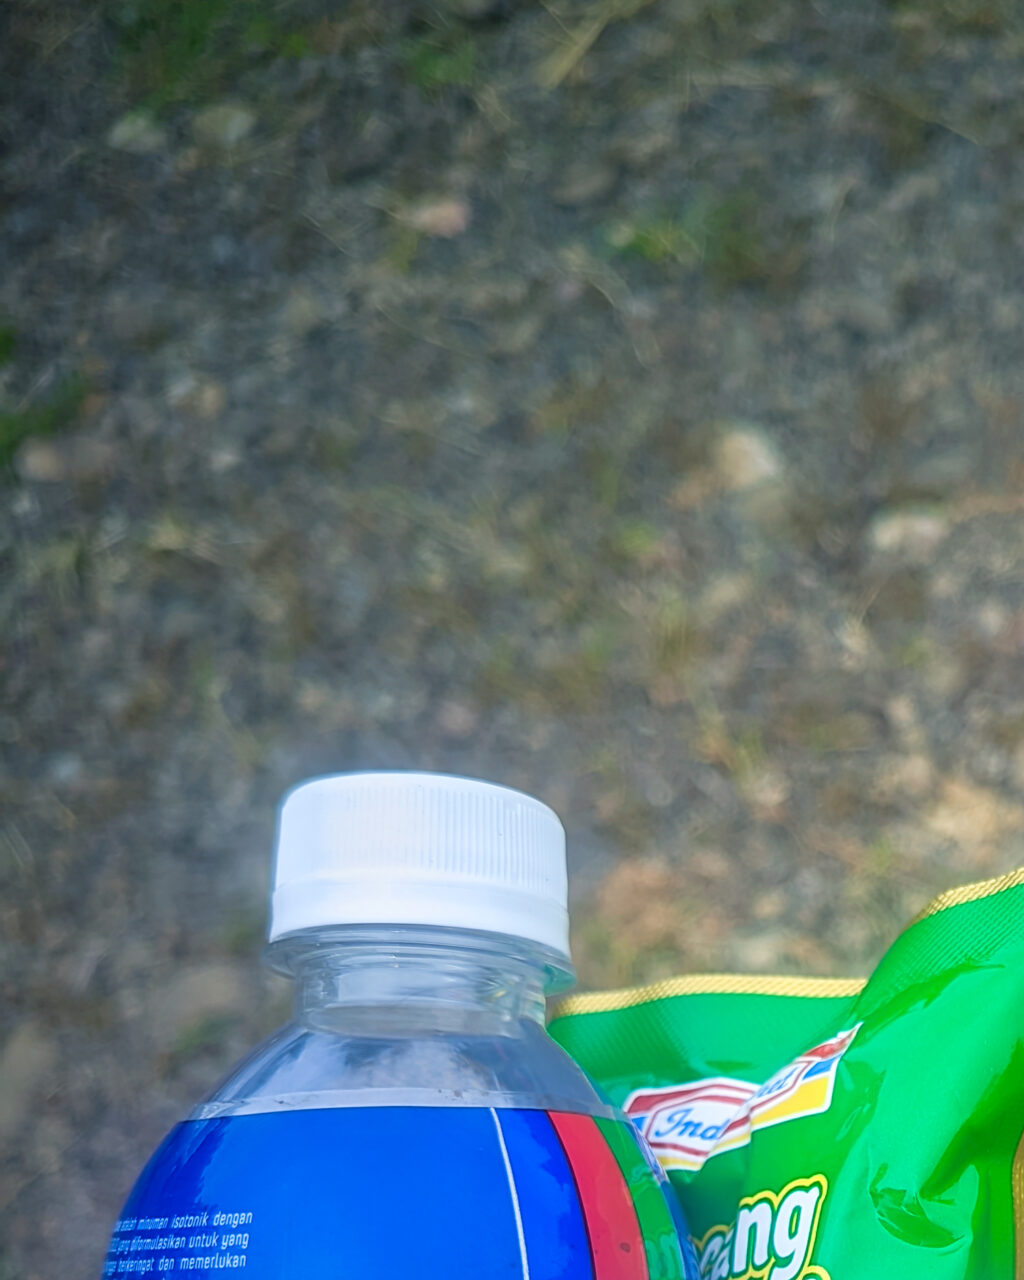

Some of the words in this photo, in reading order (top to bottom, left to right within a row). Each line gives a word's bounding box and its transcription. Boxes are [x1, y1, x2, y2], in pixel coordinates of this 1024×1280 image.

[171, 1212, 209, 1228] isotonik
[213, 1211, 253, 1229] dengan
[189, 1232, 219, 1249] untuk
[221, 1233, 249, 1250] yang
[158, 1257, 175, 1271] dan
[180, 1253, 247, 1270] memerlukan
